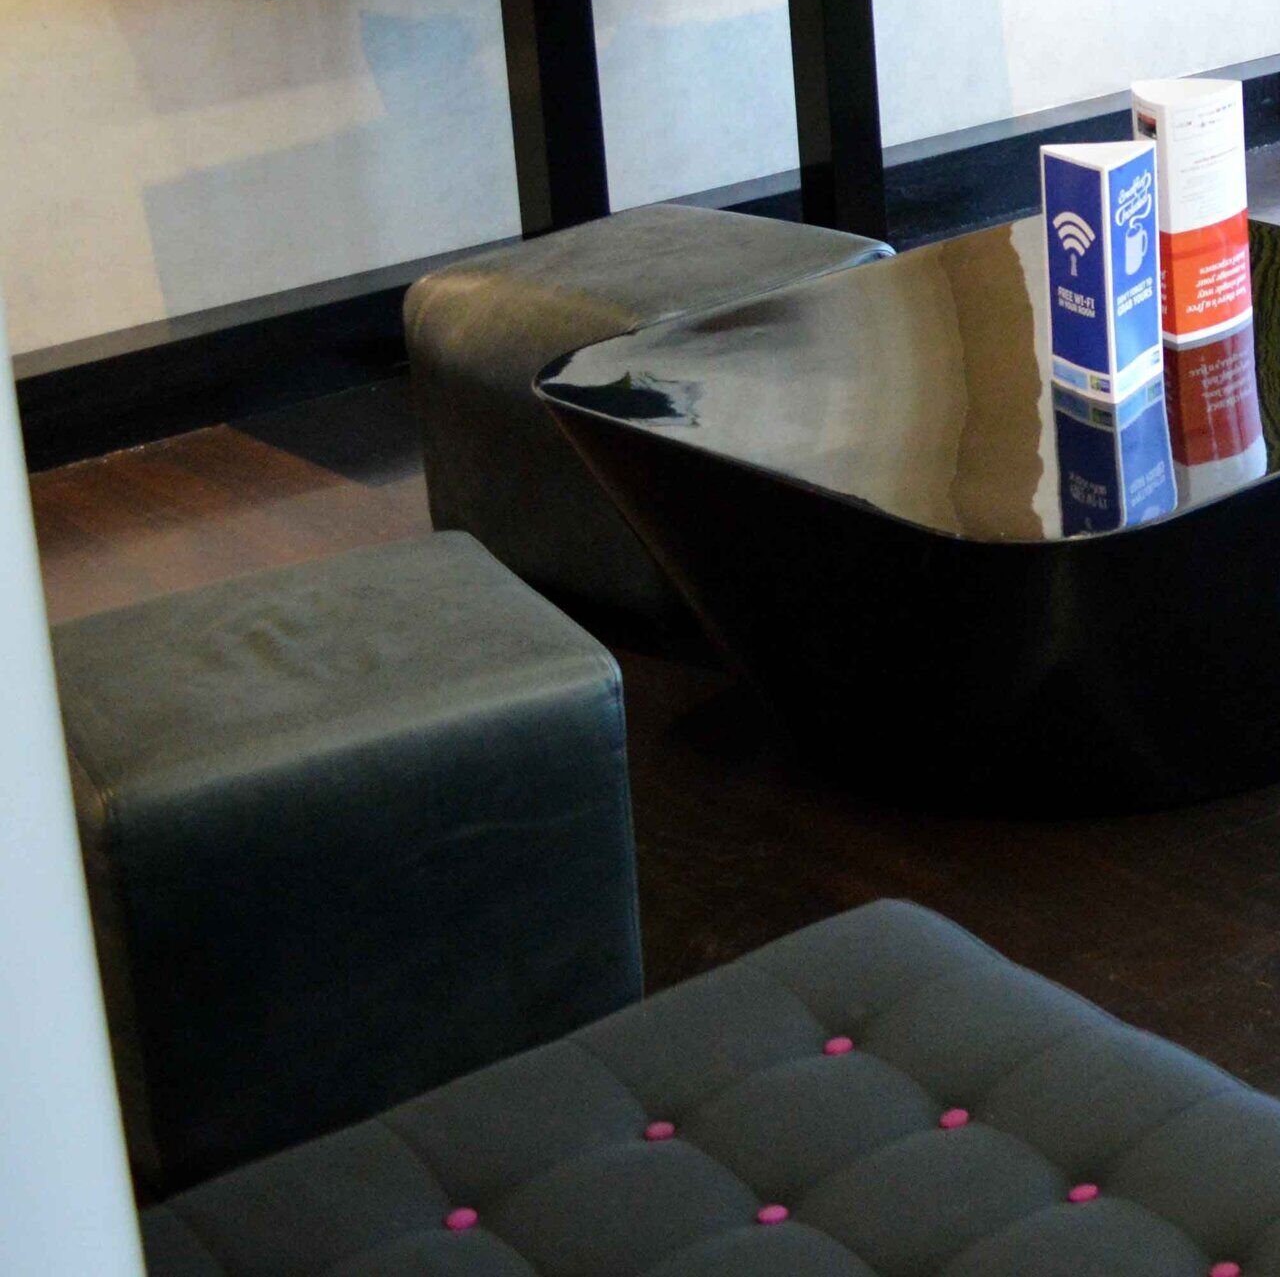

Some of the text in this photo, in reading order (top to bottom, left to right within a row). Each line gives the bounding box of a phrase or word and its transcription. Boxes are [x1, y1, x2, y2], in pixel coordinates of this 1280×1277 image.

[1058, 285, 1094, 309] FREE WI-FI
[1186, 300, 1205, 317] free
